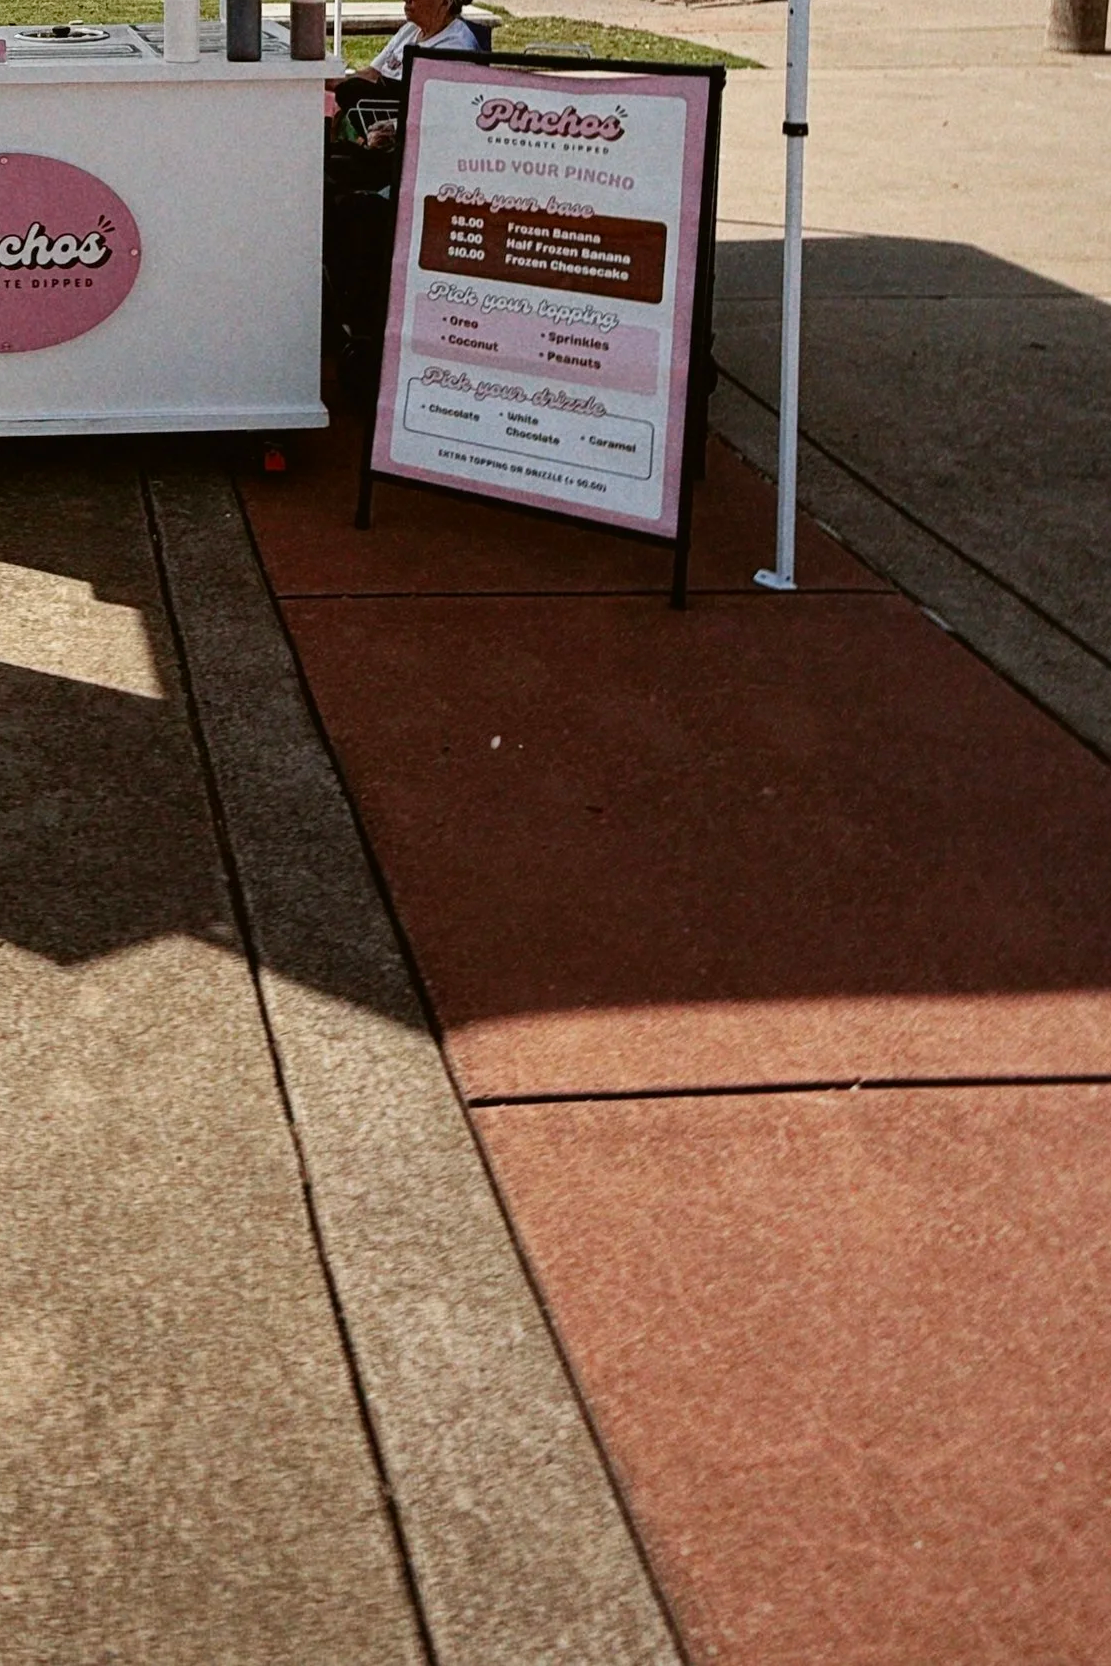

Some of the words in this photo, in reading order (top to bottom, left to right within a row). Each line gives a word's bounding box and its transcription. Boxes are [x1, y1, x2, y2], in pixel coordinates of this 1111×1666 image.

[476, 98, 625, 142] Pinchos
[487, 135, 557, 150] CHOCOLATE
[563, 142, 610, 155] DIPPED
[458, 158, 506, 173] BUILD
[511, 160, 559, 178] YOUR
[565, 165, 635, 191] PINCHO
[437, 183, 486, 205] Pick
[489, 193, 540, 213] your
[545, 195, 595, 219] base
[450, 214, 485, 230] $8.00
[507, 221, 550, 238] Frozen
[552, 228, 601, 245] Banana
[505, 237, 533, 251] Half
[534, 242, 579, 258] Frozen
[580, 248, 631, 265] Banana
[447, 245, 486, 261] $10.00
[505, 254, 547, 270] Frozen
[549, 260, 629, 282] Cheesecake
[31, 277, 94, 289] DIPPED
[427, 281, 479, 306] Pick
[480, 292, 533, 315] your
[536, 298, 620, 333] topping
[449, 315, 479, 330] Oreo
[447, 333, 499, 352] Coconut
[547, 331, 610, 352] Sprinkles
[546, 350, 602, 370] Peanuts
[421, 366, 472, 392] Pick
[473, 380, 527, 403] your
[532, 387, 607, 418] drizzle
[428, 403, 481, 422] Chocolate
[506, 411, 539, 426] White
[504, 426, 560, 445] Chocolate
[588, 434, 637, 454] Caramel
[437, 448, 467, 463] EXTRA
[469, 454, 508, 472] TOPPING
[509, 463, 524, 475] OR
[525, 466, 563, 484] DRIZZLE
